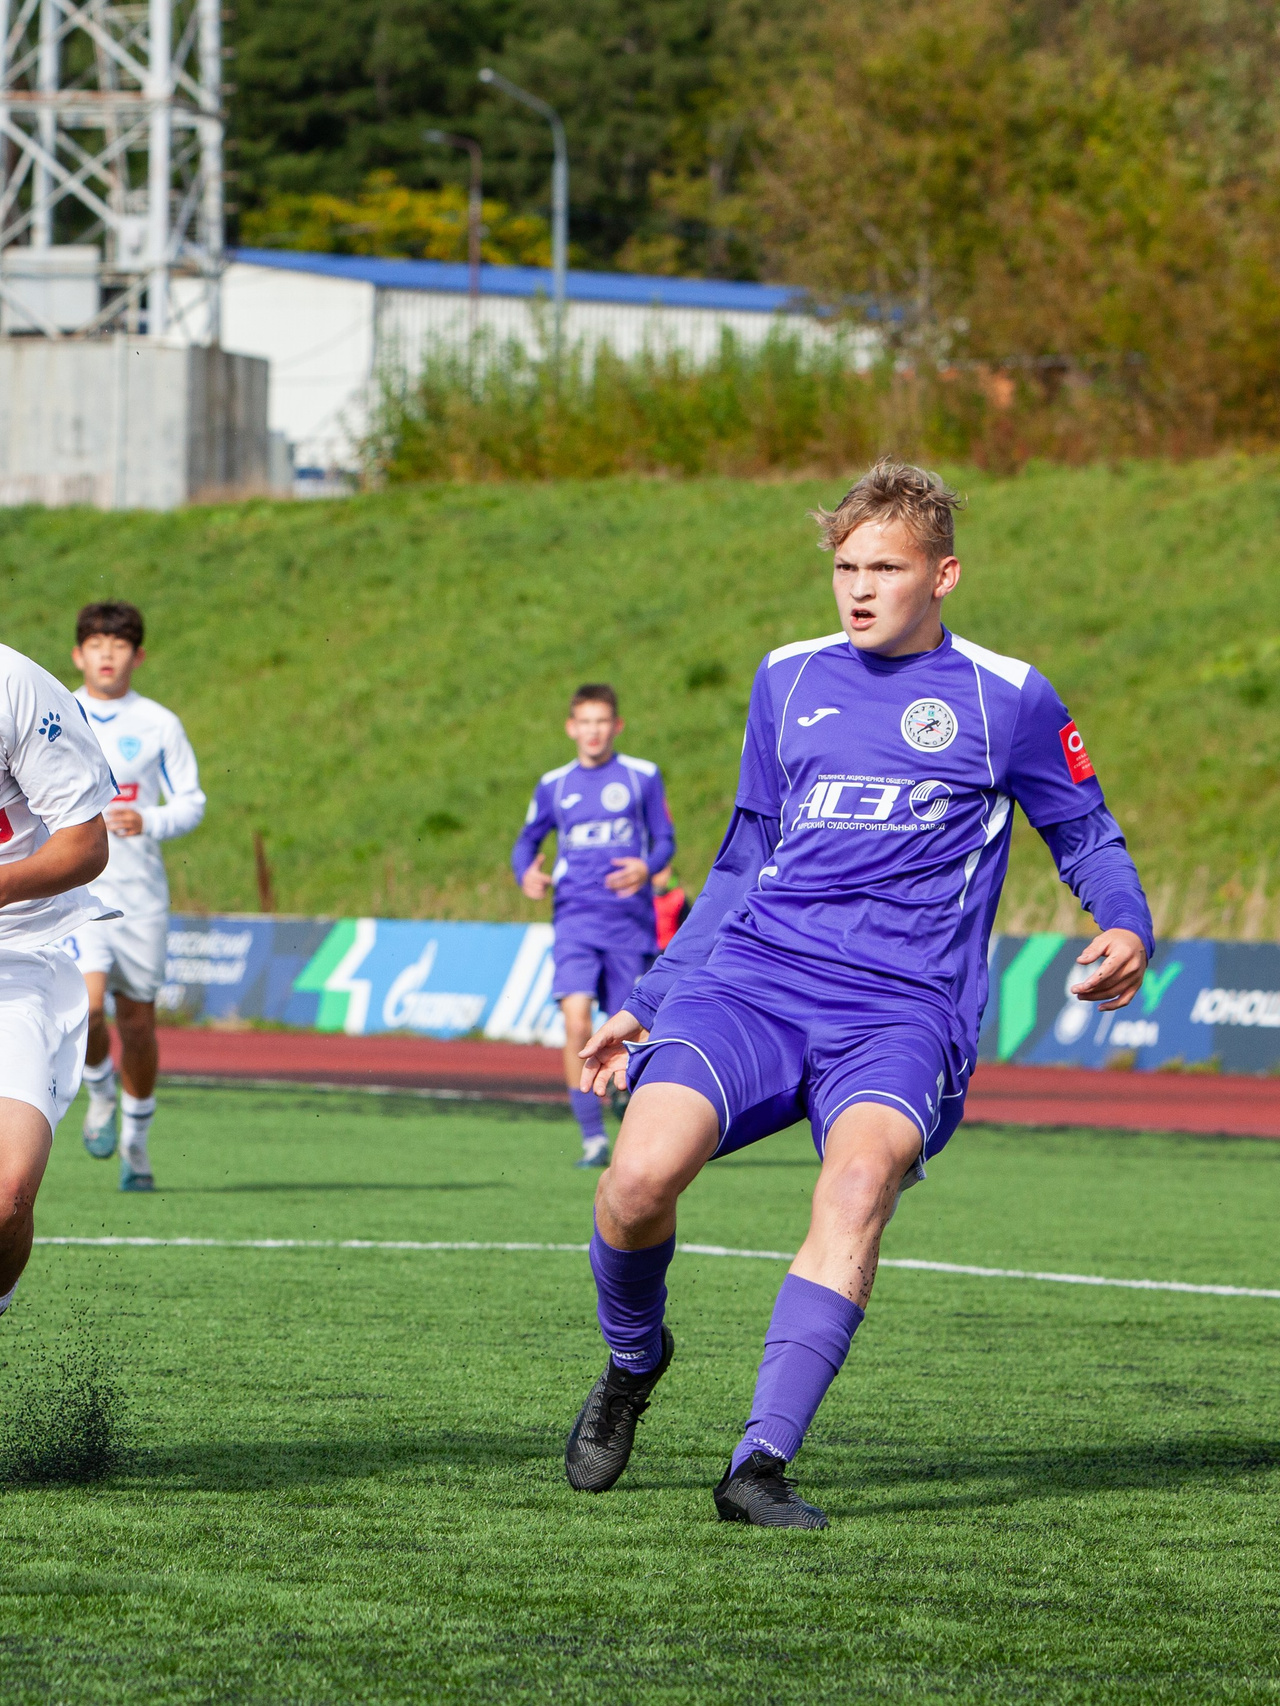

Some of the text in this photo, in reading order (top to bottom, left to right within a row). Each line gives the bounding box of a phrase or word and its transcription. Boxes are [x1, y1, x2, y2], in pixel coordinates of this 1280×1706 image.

[885, 777, 916, 786] ОБЩЕСТВО
[791, 781, 901, 831] АСЗ
[827, 821, 918, 831] СУДОСТРОИТЕЛЬНЫЙ
